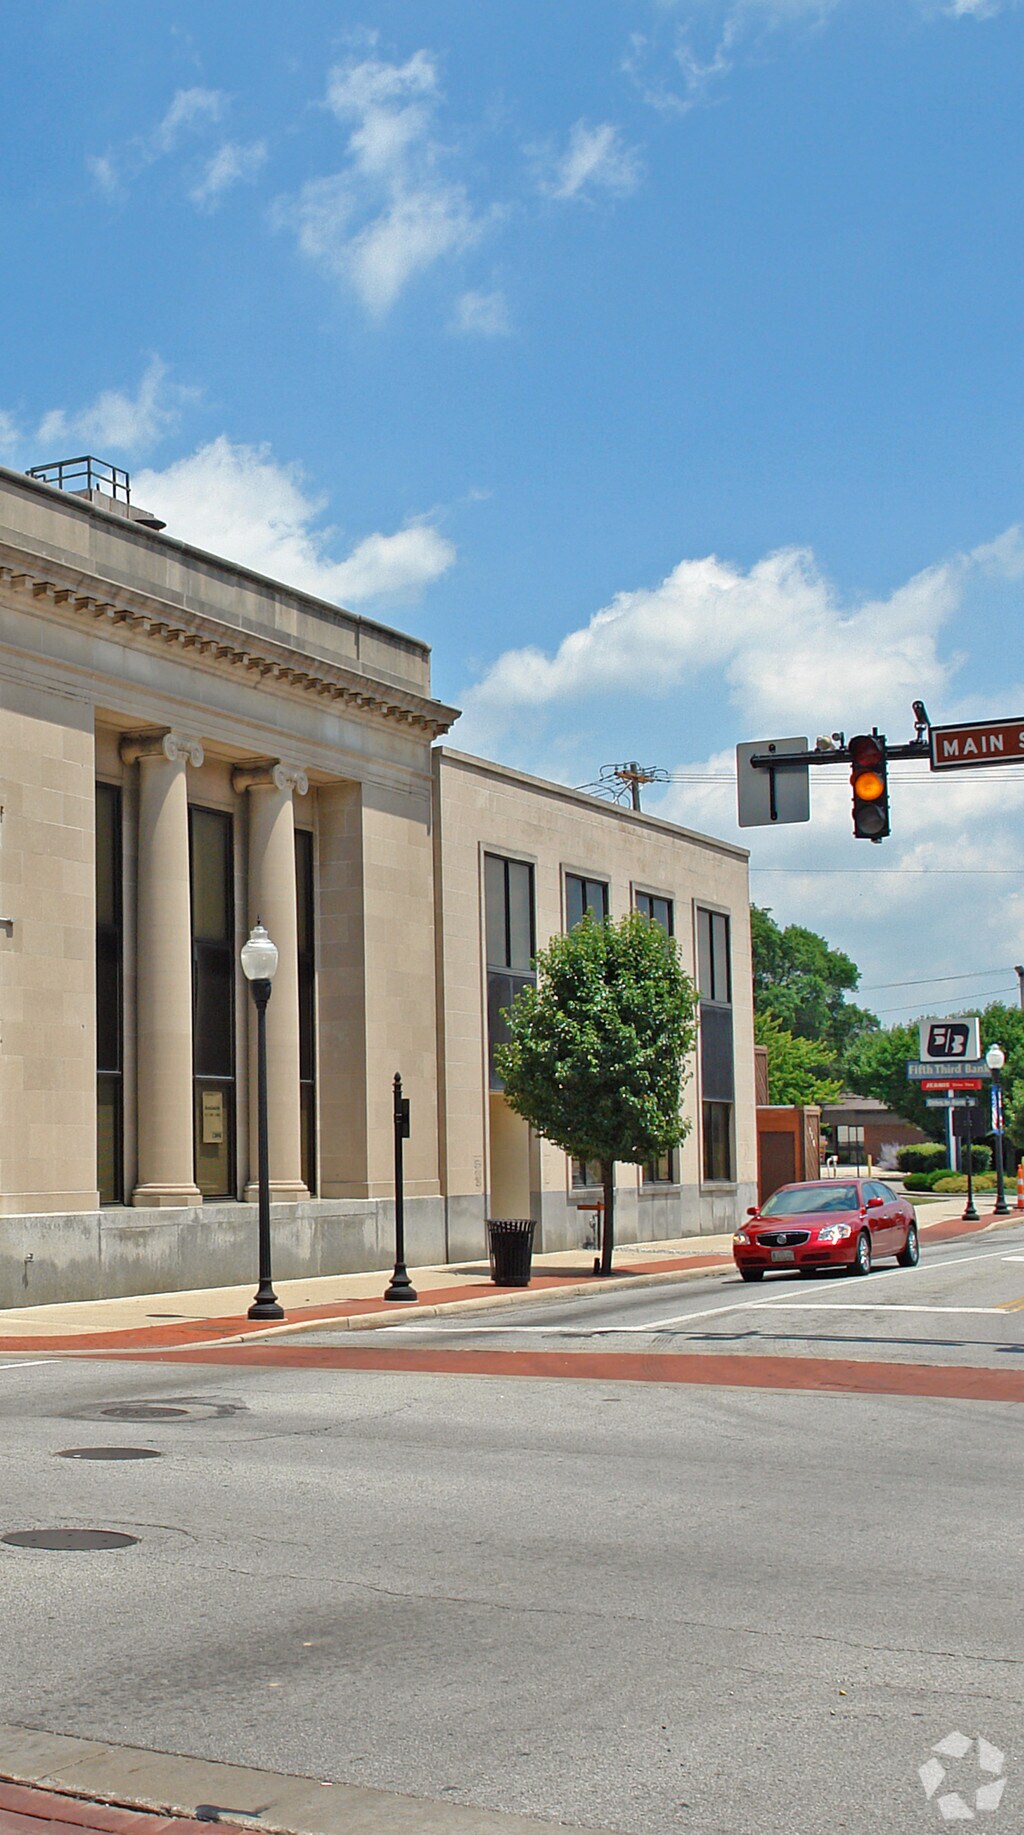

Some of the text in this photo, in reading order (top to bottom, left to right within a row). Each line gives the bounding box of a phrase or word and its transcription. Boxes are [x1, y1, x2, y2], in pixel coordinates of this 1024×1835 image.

[943, 734, 1004, 757] MAIN
[908, 1063, 990, 1075] Fifth Third Bank
